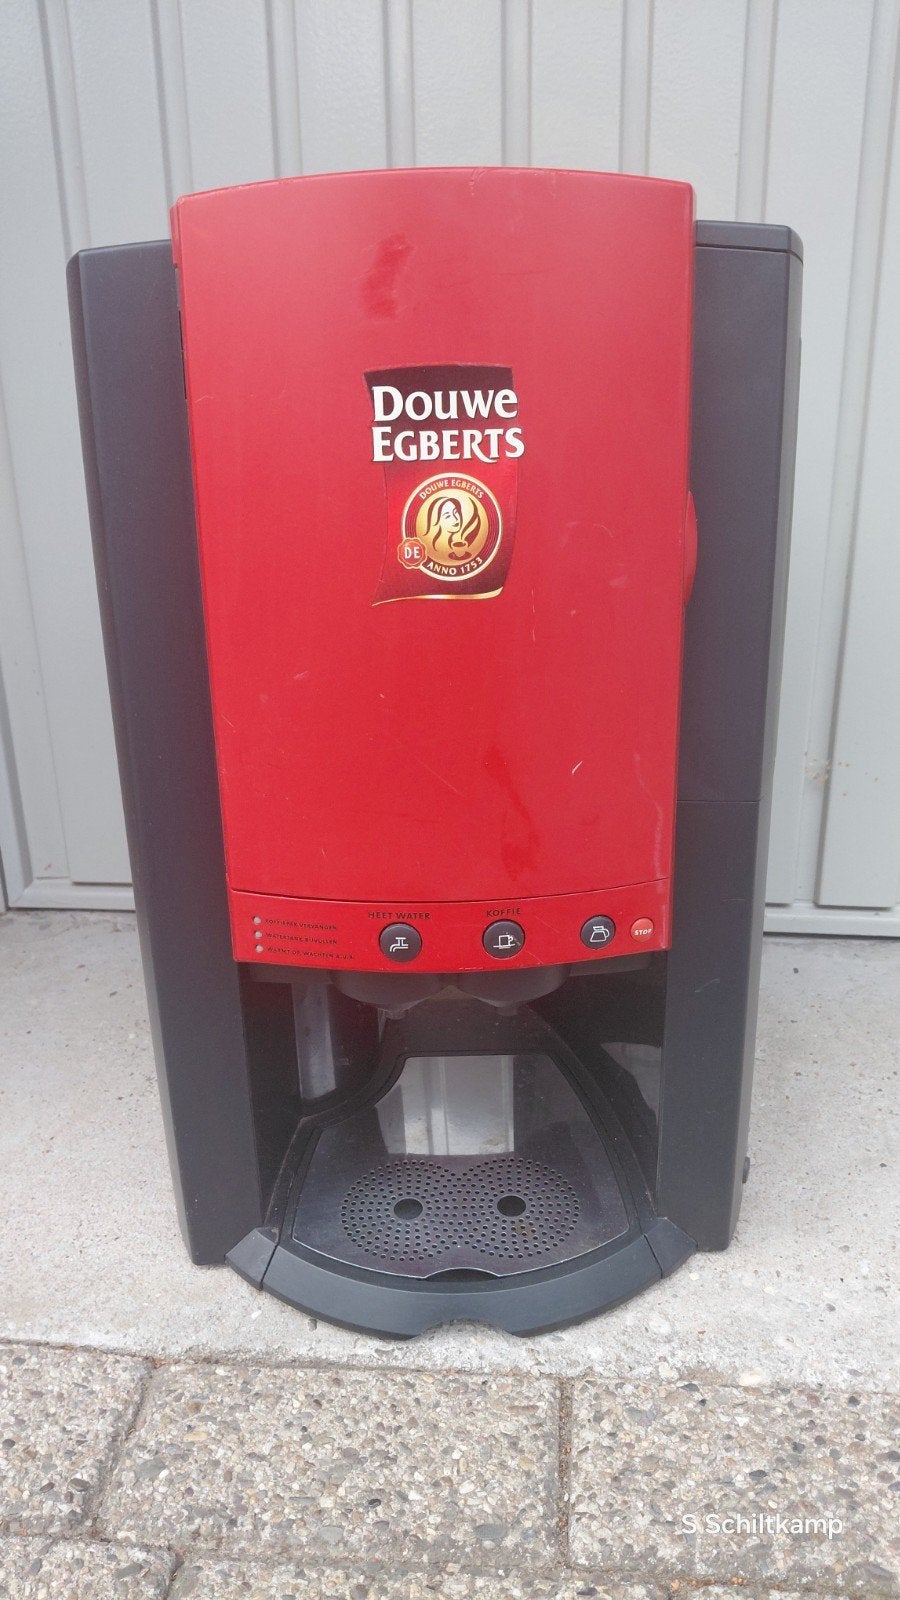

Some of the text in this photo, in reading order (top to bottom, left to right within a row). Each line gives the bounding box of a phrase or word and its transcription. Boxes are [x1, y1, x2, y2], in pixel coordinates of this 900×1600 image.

[371, 426, 526, 463] EGBERTS
[419, 479, 484, 500] DOUWE EGBERTS
[427, 556, 483, 575] ANNO 1753
[395, 912, 431, 920] WATER
[486, 907, 521, 918] KOFFIE
[634, 928, 652, 936] STOP
